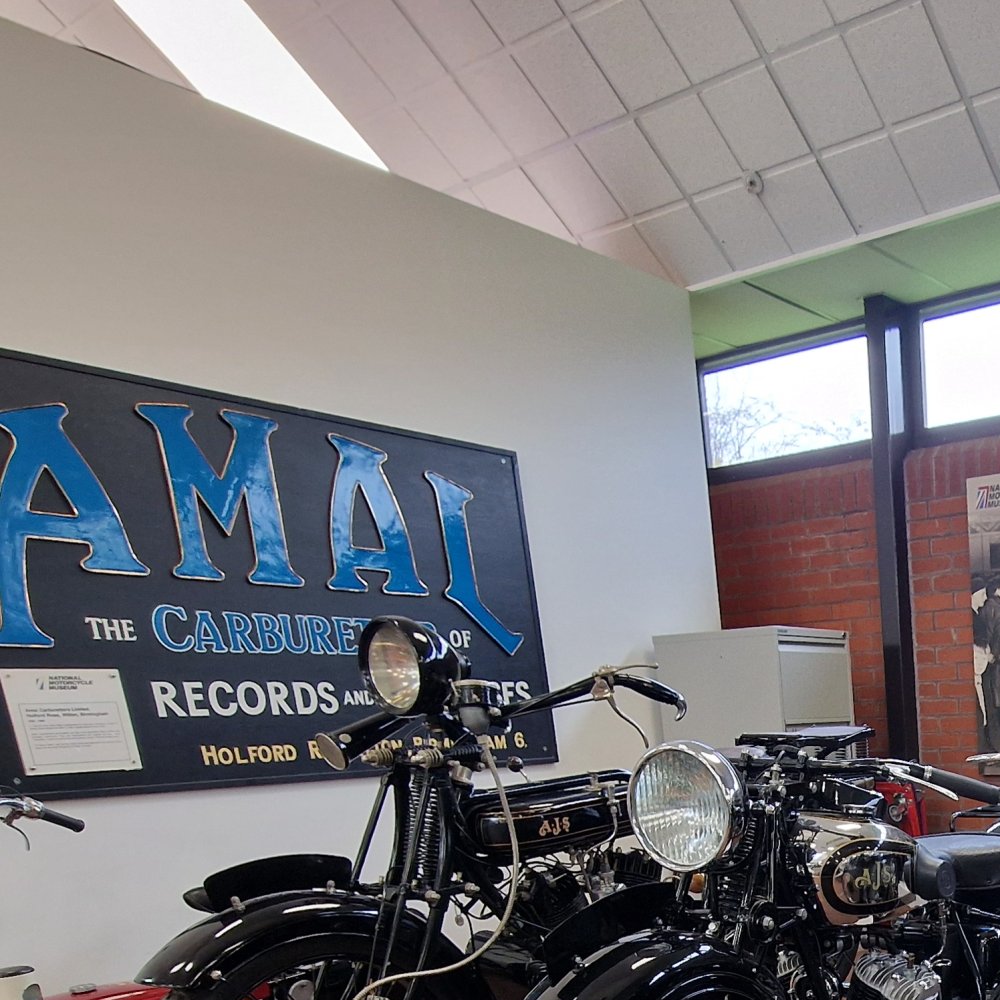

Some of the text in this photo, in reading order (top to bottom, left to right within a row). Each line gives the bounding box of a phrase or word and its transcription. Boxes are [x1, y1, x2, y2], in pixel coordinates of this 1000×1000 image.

[0, 402, 523, 656] AMAL
[85, 604, 472, 655] THE CARBURE OF
[151, 681, 375, 718] RECORDS AND
[201, 744, 297, 766] HOLFORD
